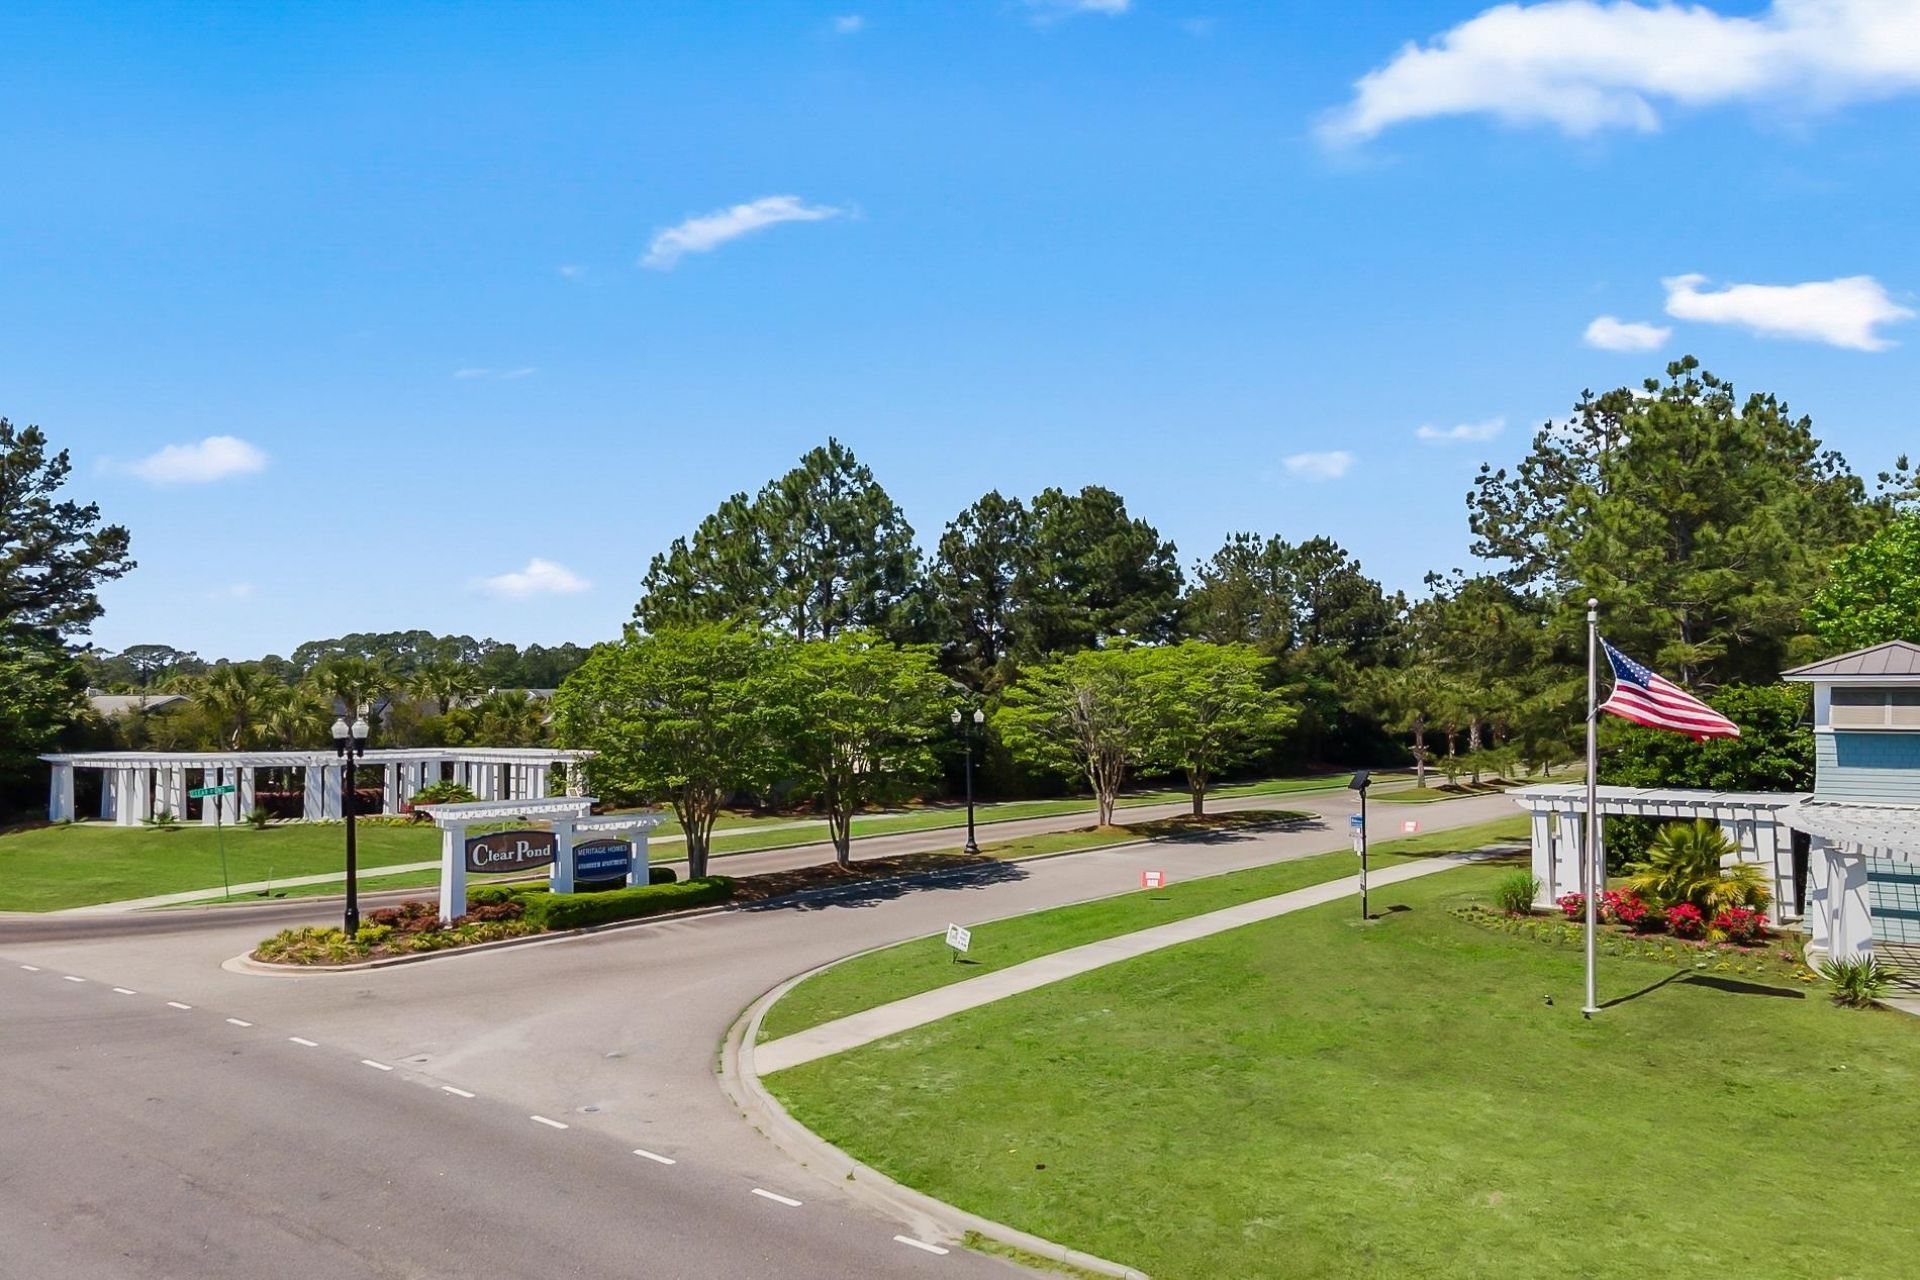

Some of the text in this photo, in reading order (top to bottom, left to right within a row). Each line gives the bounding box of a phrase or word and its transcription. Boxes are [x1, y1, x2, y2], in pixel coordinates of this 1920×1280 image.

[472, 840, 550, 867] Clear Pond
[577, 846, 607, 856] MERITAGE
